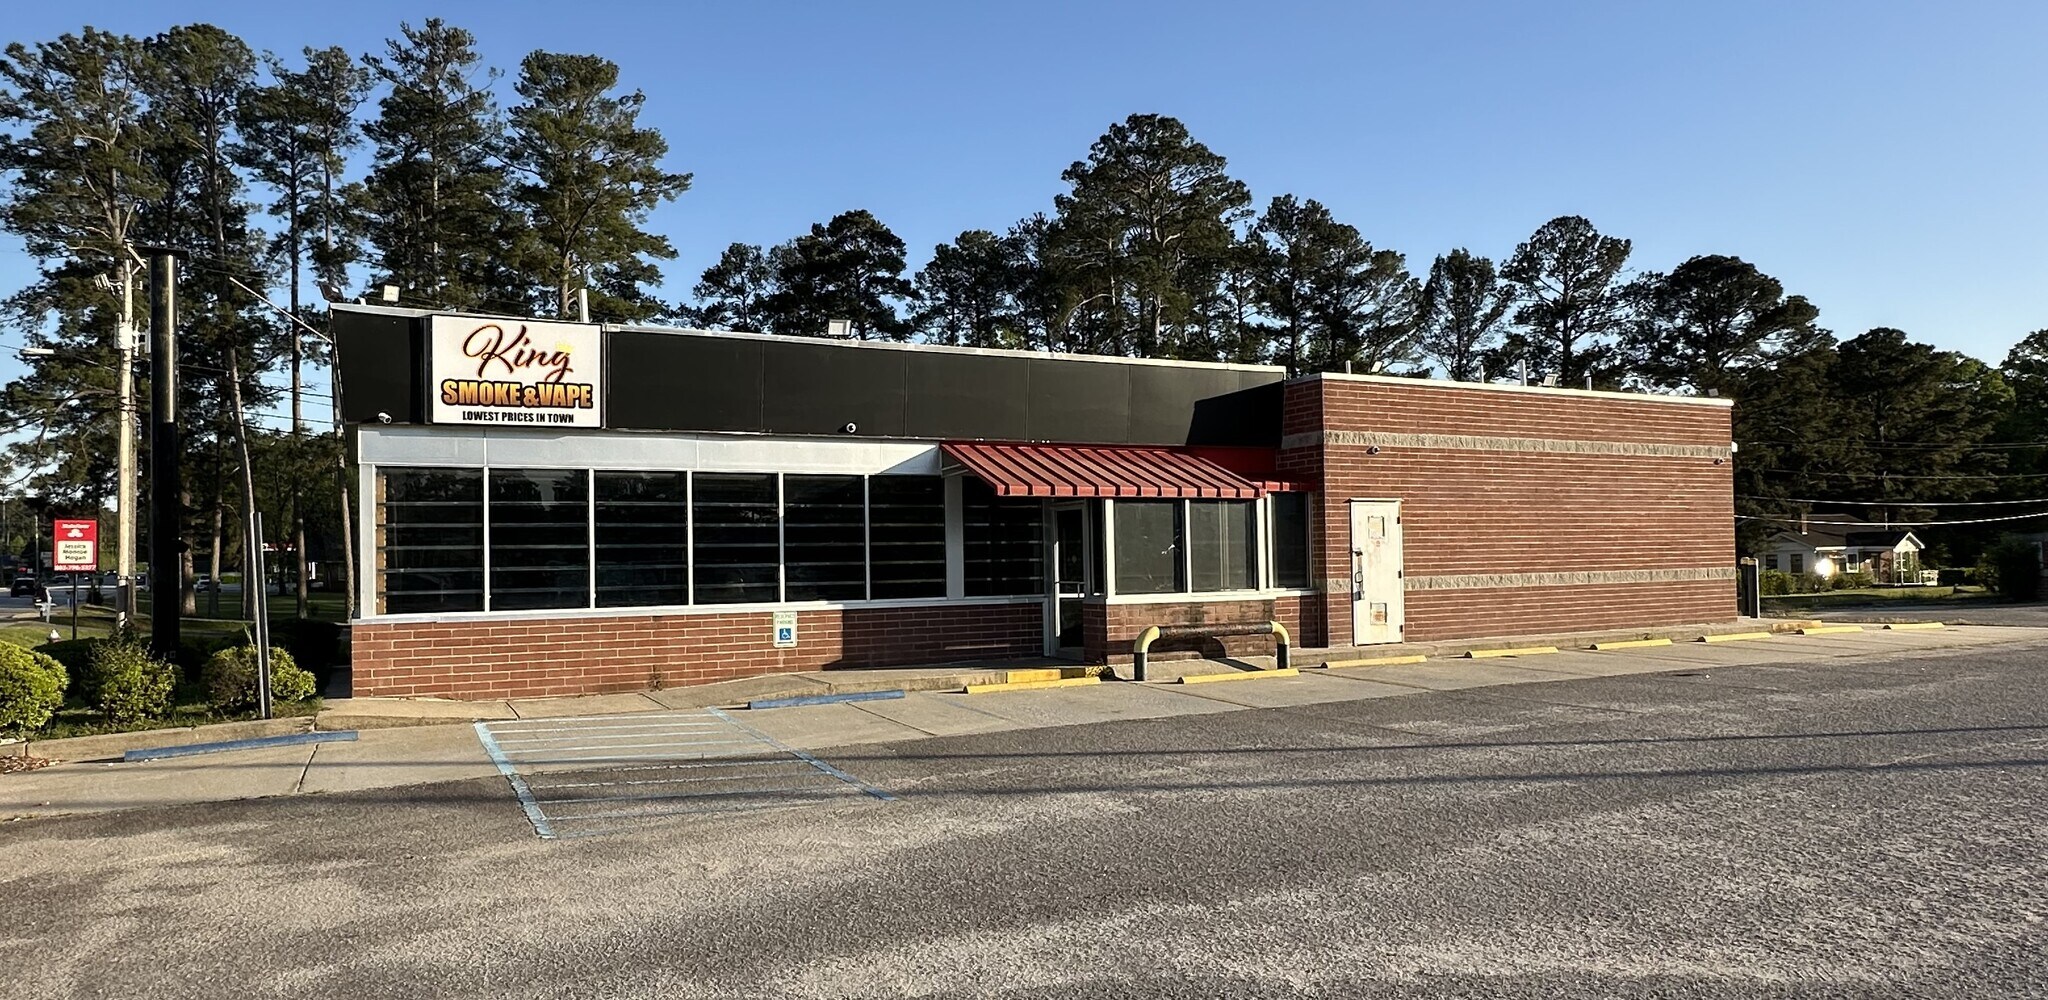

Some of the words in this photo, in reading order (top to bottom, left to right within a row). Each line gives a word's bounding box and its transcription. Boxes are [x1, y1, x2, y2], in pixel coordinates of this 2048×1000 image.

[462, 324, 574, 382] King
[441, 378, 522, 406] SMOKE
[536, 381, 593, 409] VAPE
[462, 410, 500, 422] LOWEST
[501, 411, 535, 423] PRICES
[536, 413, 545, 423] IN
[547, 413, 575, 424] TOWN
